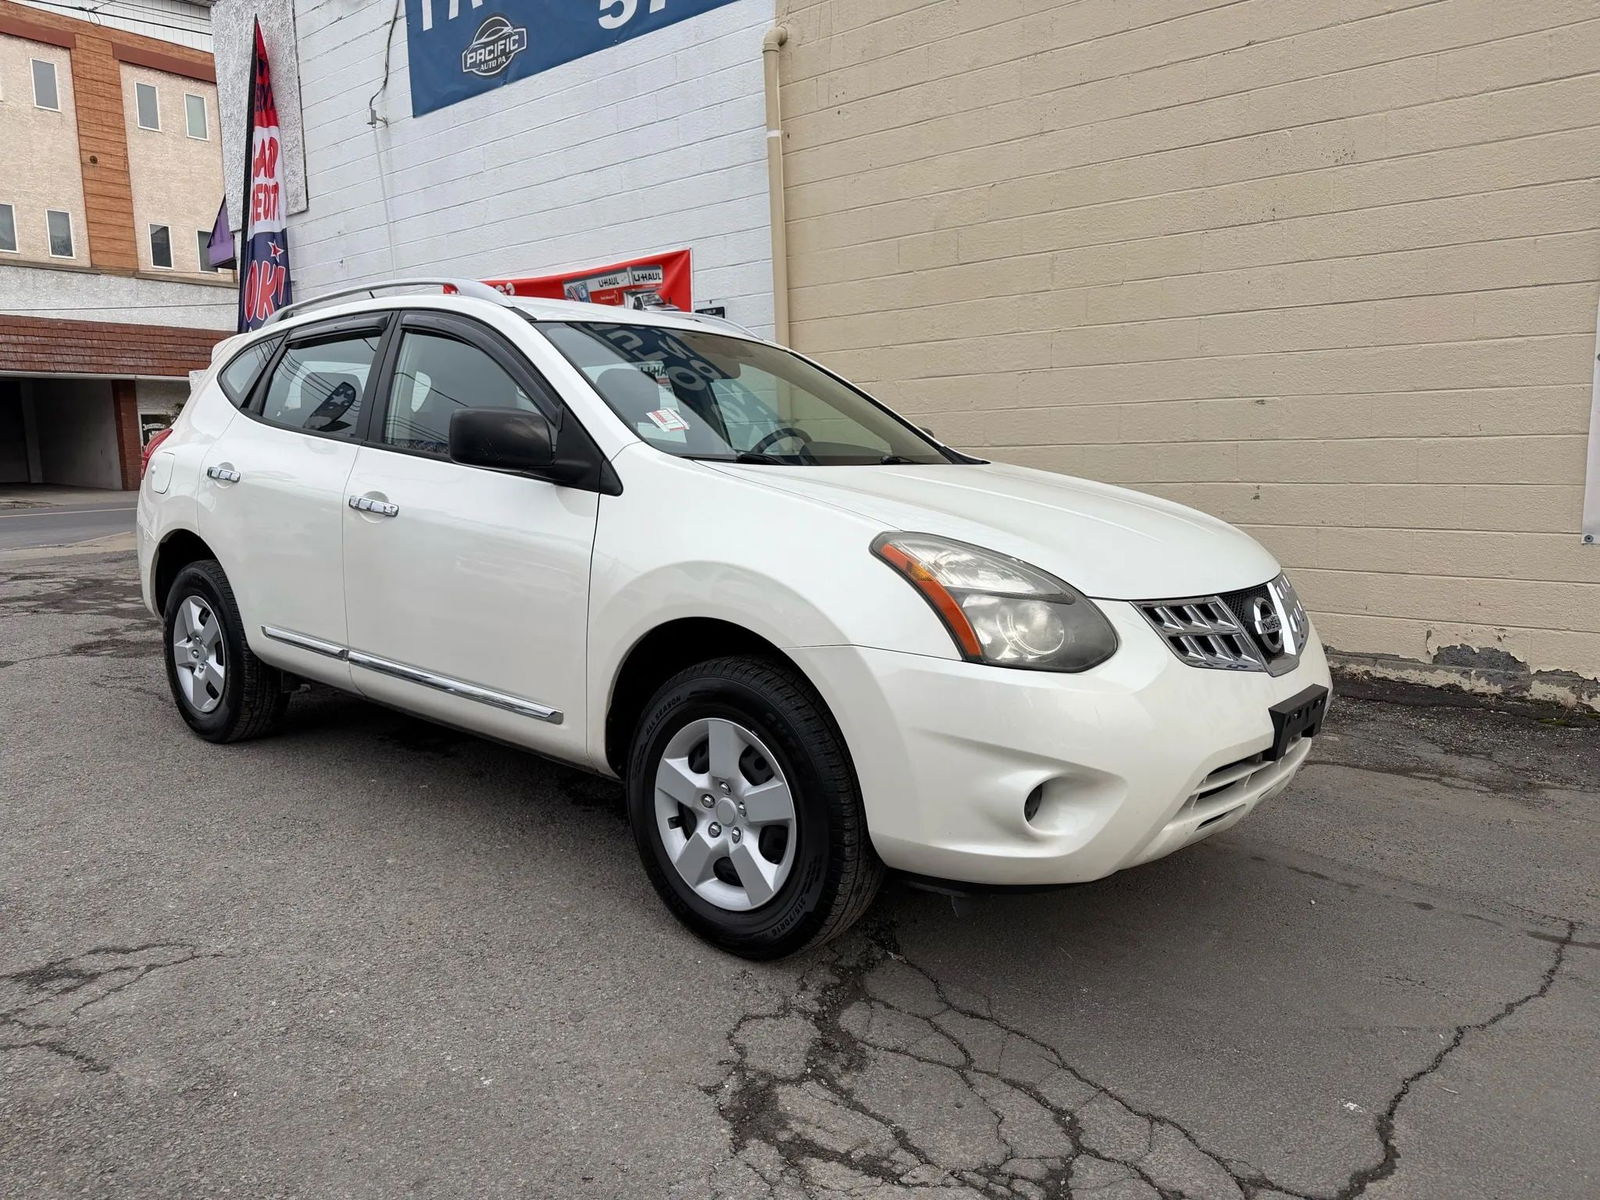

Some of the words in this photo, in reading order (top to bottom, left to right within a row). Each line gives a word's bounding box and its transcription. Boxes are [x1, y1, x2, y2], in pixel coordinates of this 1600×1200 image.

[467, 35, 519, 67] PACIFIC
[480, 59, 496, 71] AUTO
[497, 56, 506, 65] PA
[253, 137, 279, 180] AD
[598, 277, 620, 288] U-HAUL
[633, 272, 662, 282] U-HAUL
